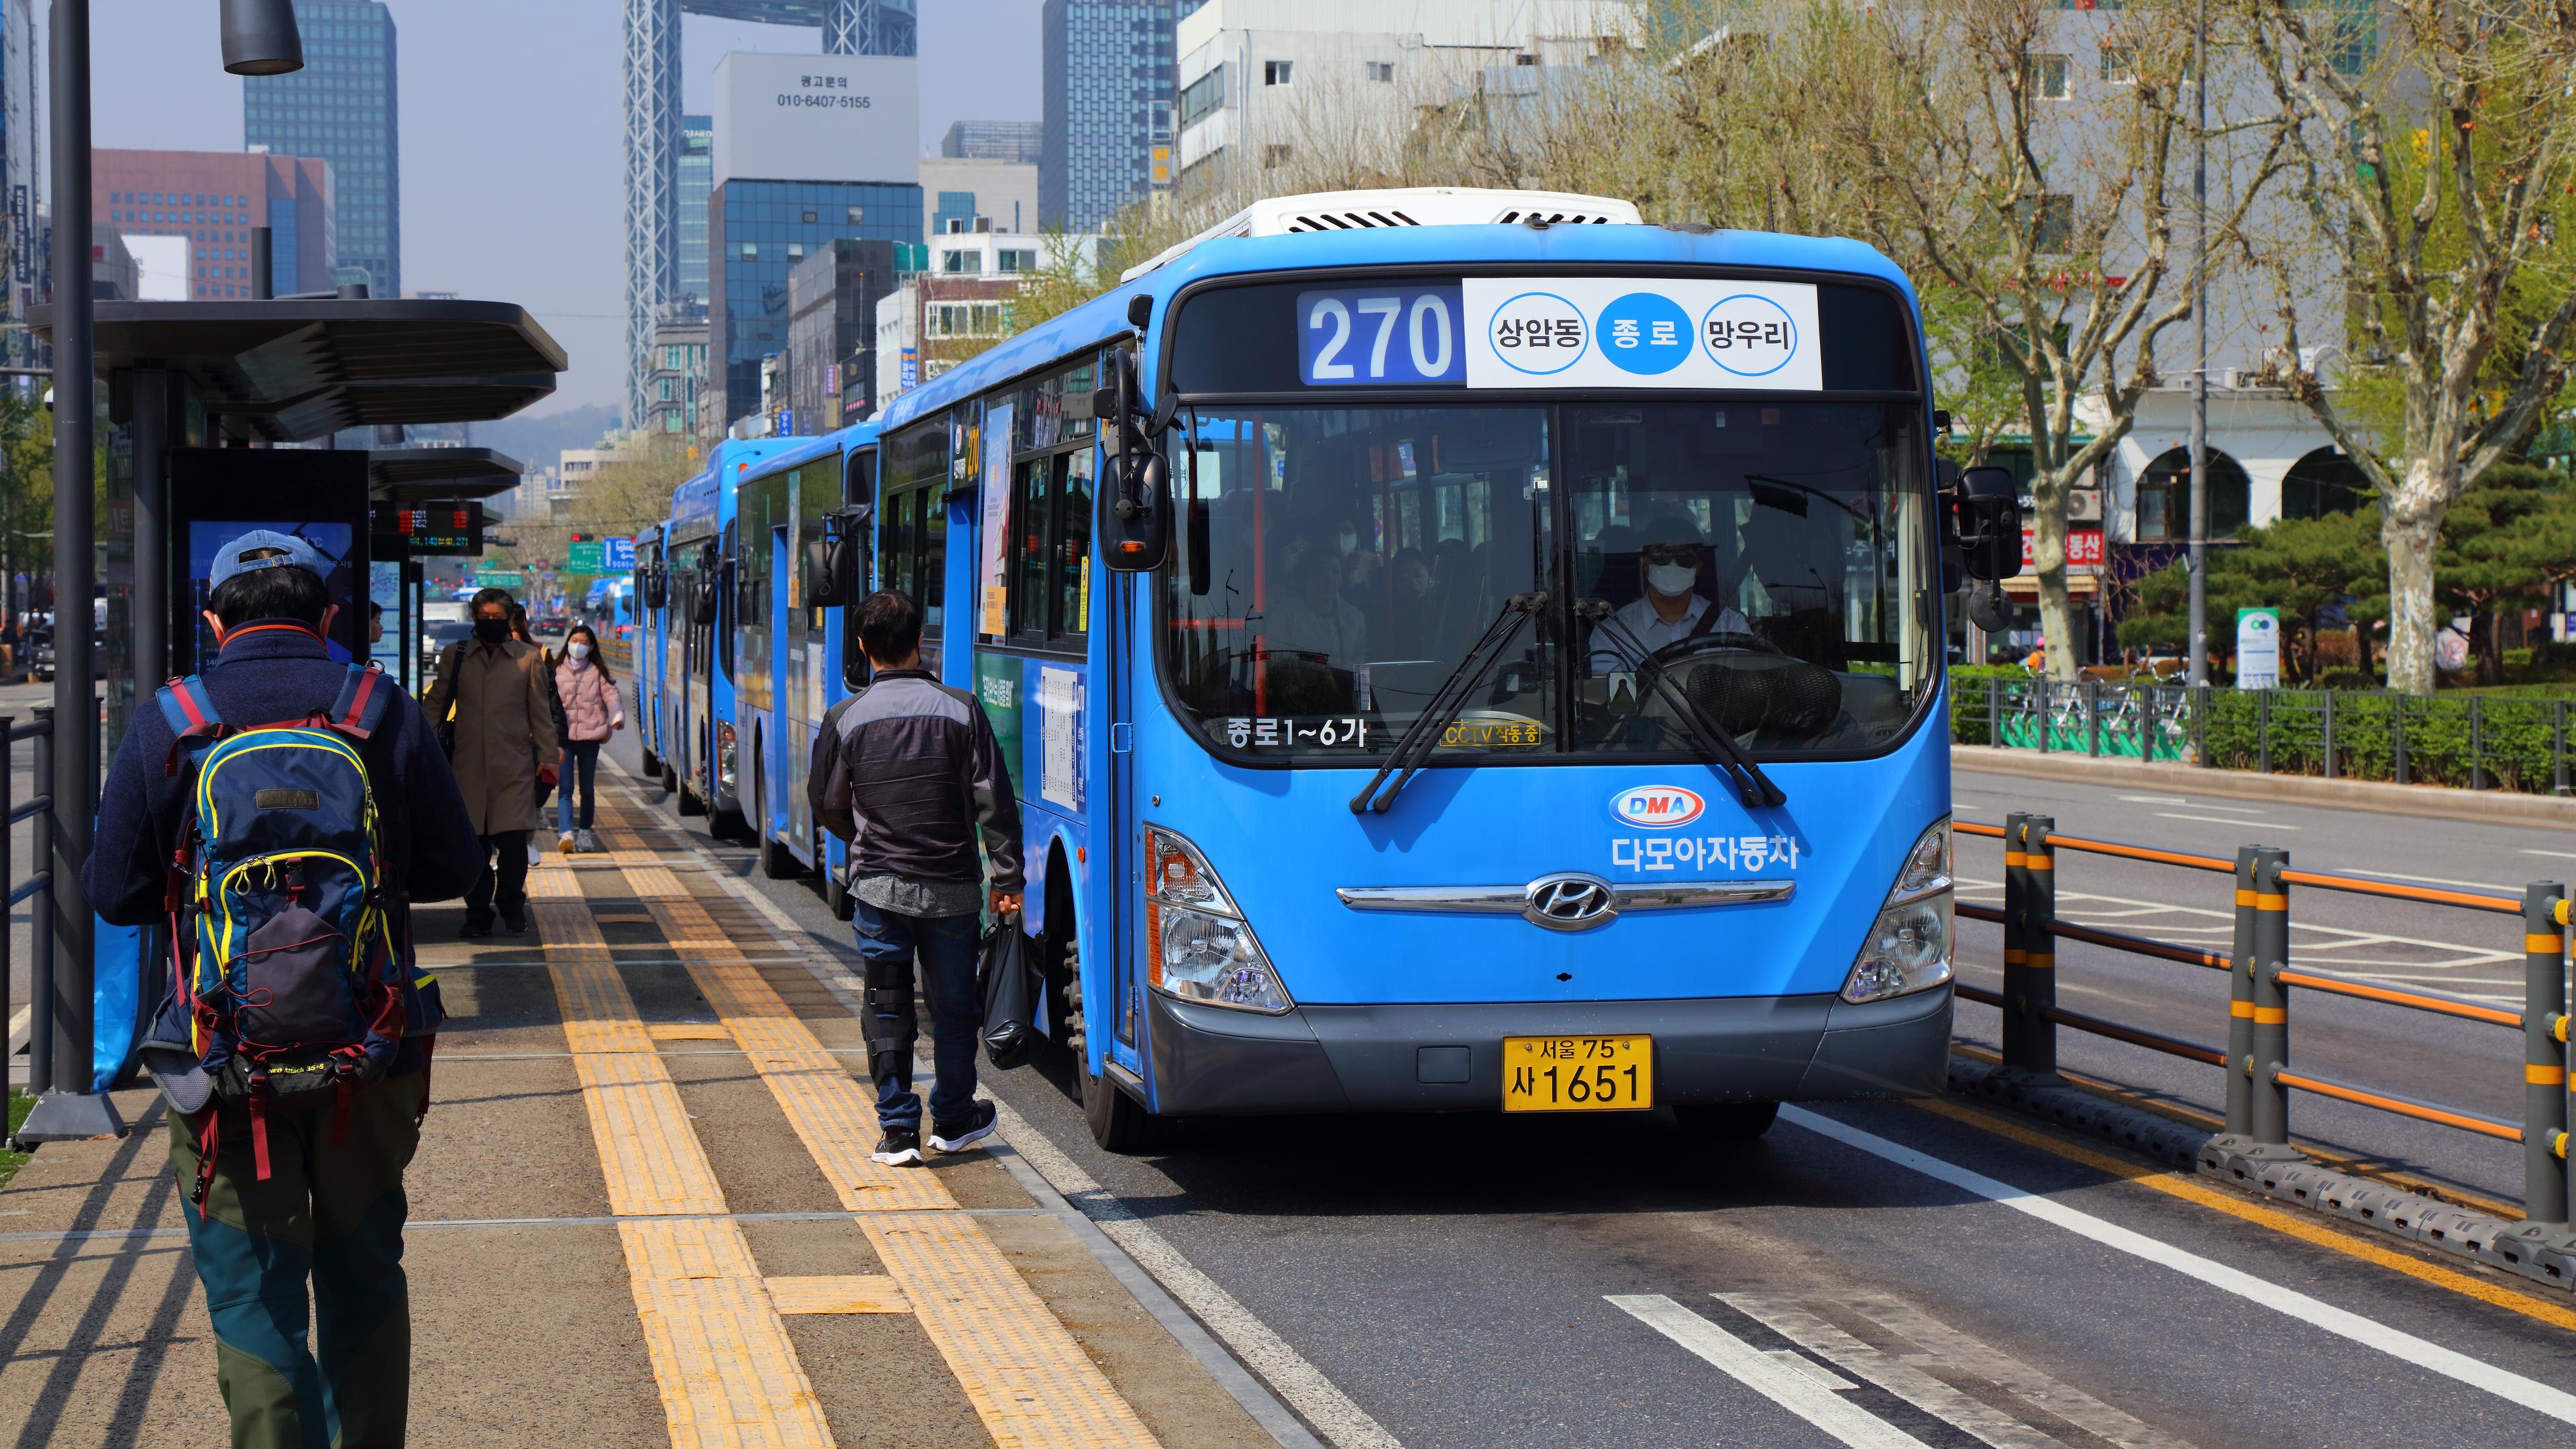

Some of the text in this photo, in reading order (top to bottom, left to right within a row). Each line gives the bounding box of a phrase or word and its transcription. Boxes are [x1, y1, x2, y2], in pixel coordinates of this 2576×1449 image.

[801, 75, 848, 88] 광고문의
[1309, 293, 1453, 380] 270
[1497, 317, 1582, 349] 상암동
[1708, 317, 1790, 350] 망우리
[967, 427, 979, 475] 270
[1227, 717, 1367, 748] 종로1~6가
[1445, 726, 1493, 744] CCTV
[1629, 796, 1686, 815] DMA
[1613, 835, 1800, 872] 다모아자동차
[1539, 1039, 1615, 1060] 서울 75
